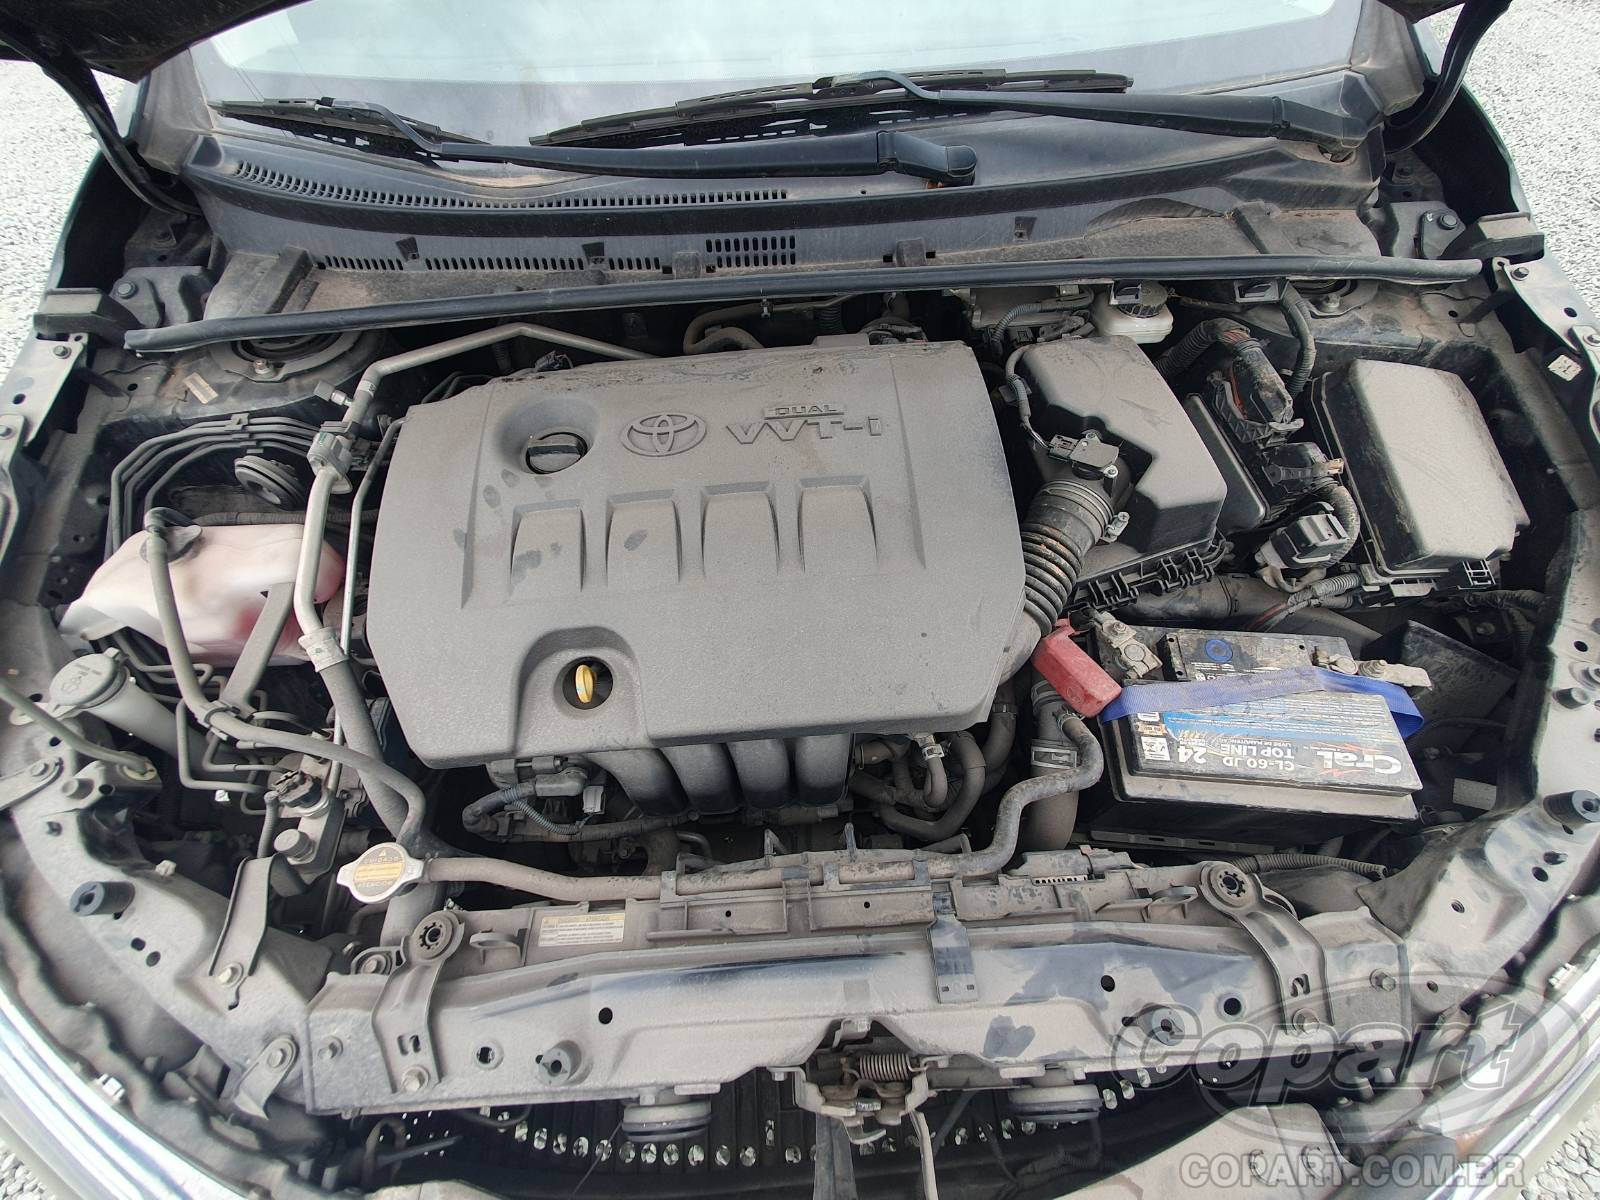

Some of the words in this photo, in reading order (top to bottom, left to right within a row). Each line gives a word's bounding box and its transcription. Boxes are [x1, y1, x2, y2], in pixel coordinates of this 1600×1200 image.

[774, 404, 838, 415] DUAL
[1178, 746, 1206, 764] 24
[1220, 743, 1257, 757] LINE
[1260, 746, 1295, 760] TOP
[1222, 756, 1245, 768] JD
[1246, 758, 1295, 771] CL-60
